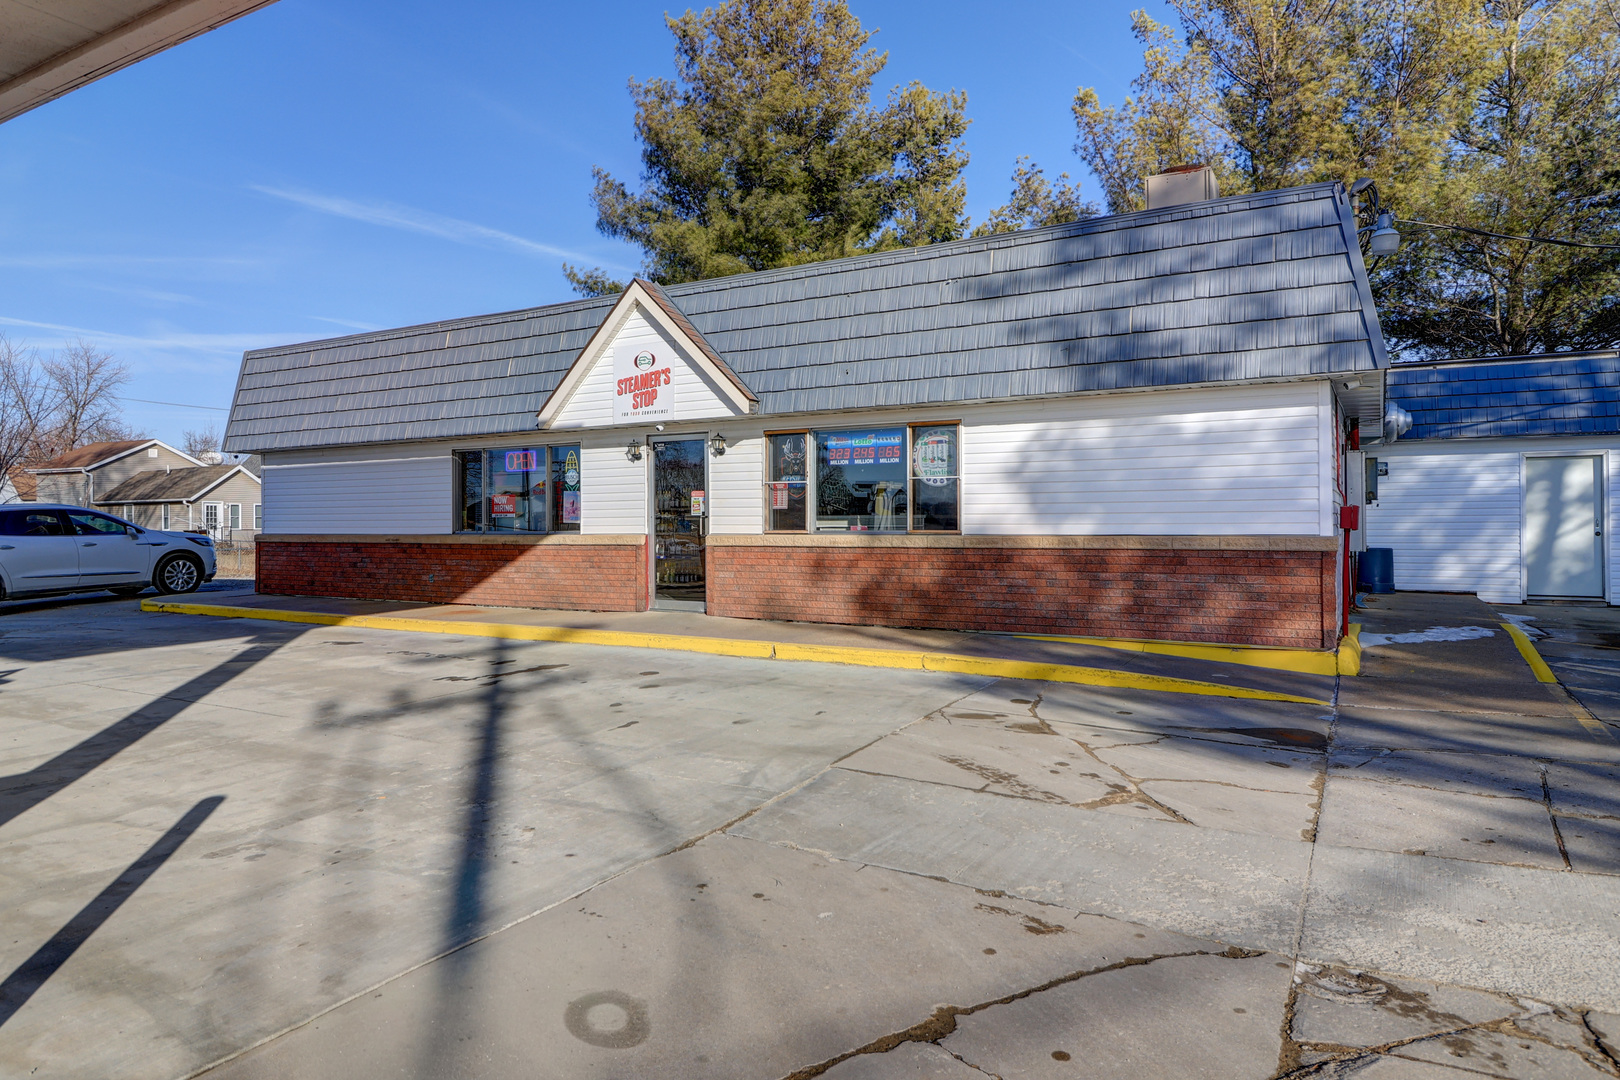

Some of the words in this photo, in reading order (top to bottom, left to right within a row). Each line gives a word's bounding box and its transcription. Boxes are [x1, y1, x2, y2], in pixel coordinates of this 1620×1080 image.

[617, 367, 671, 396] STEAMER'S
[632, 389, 658, 410] STOP
[853, 438, 872, 446] Lotto
[507, 452, 535, 470] OPEN
[493, 496, 508, 505] NOW
[494, 504, 514, 512] HIRING
